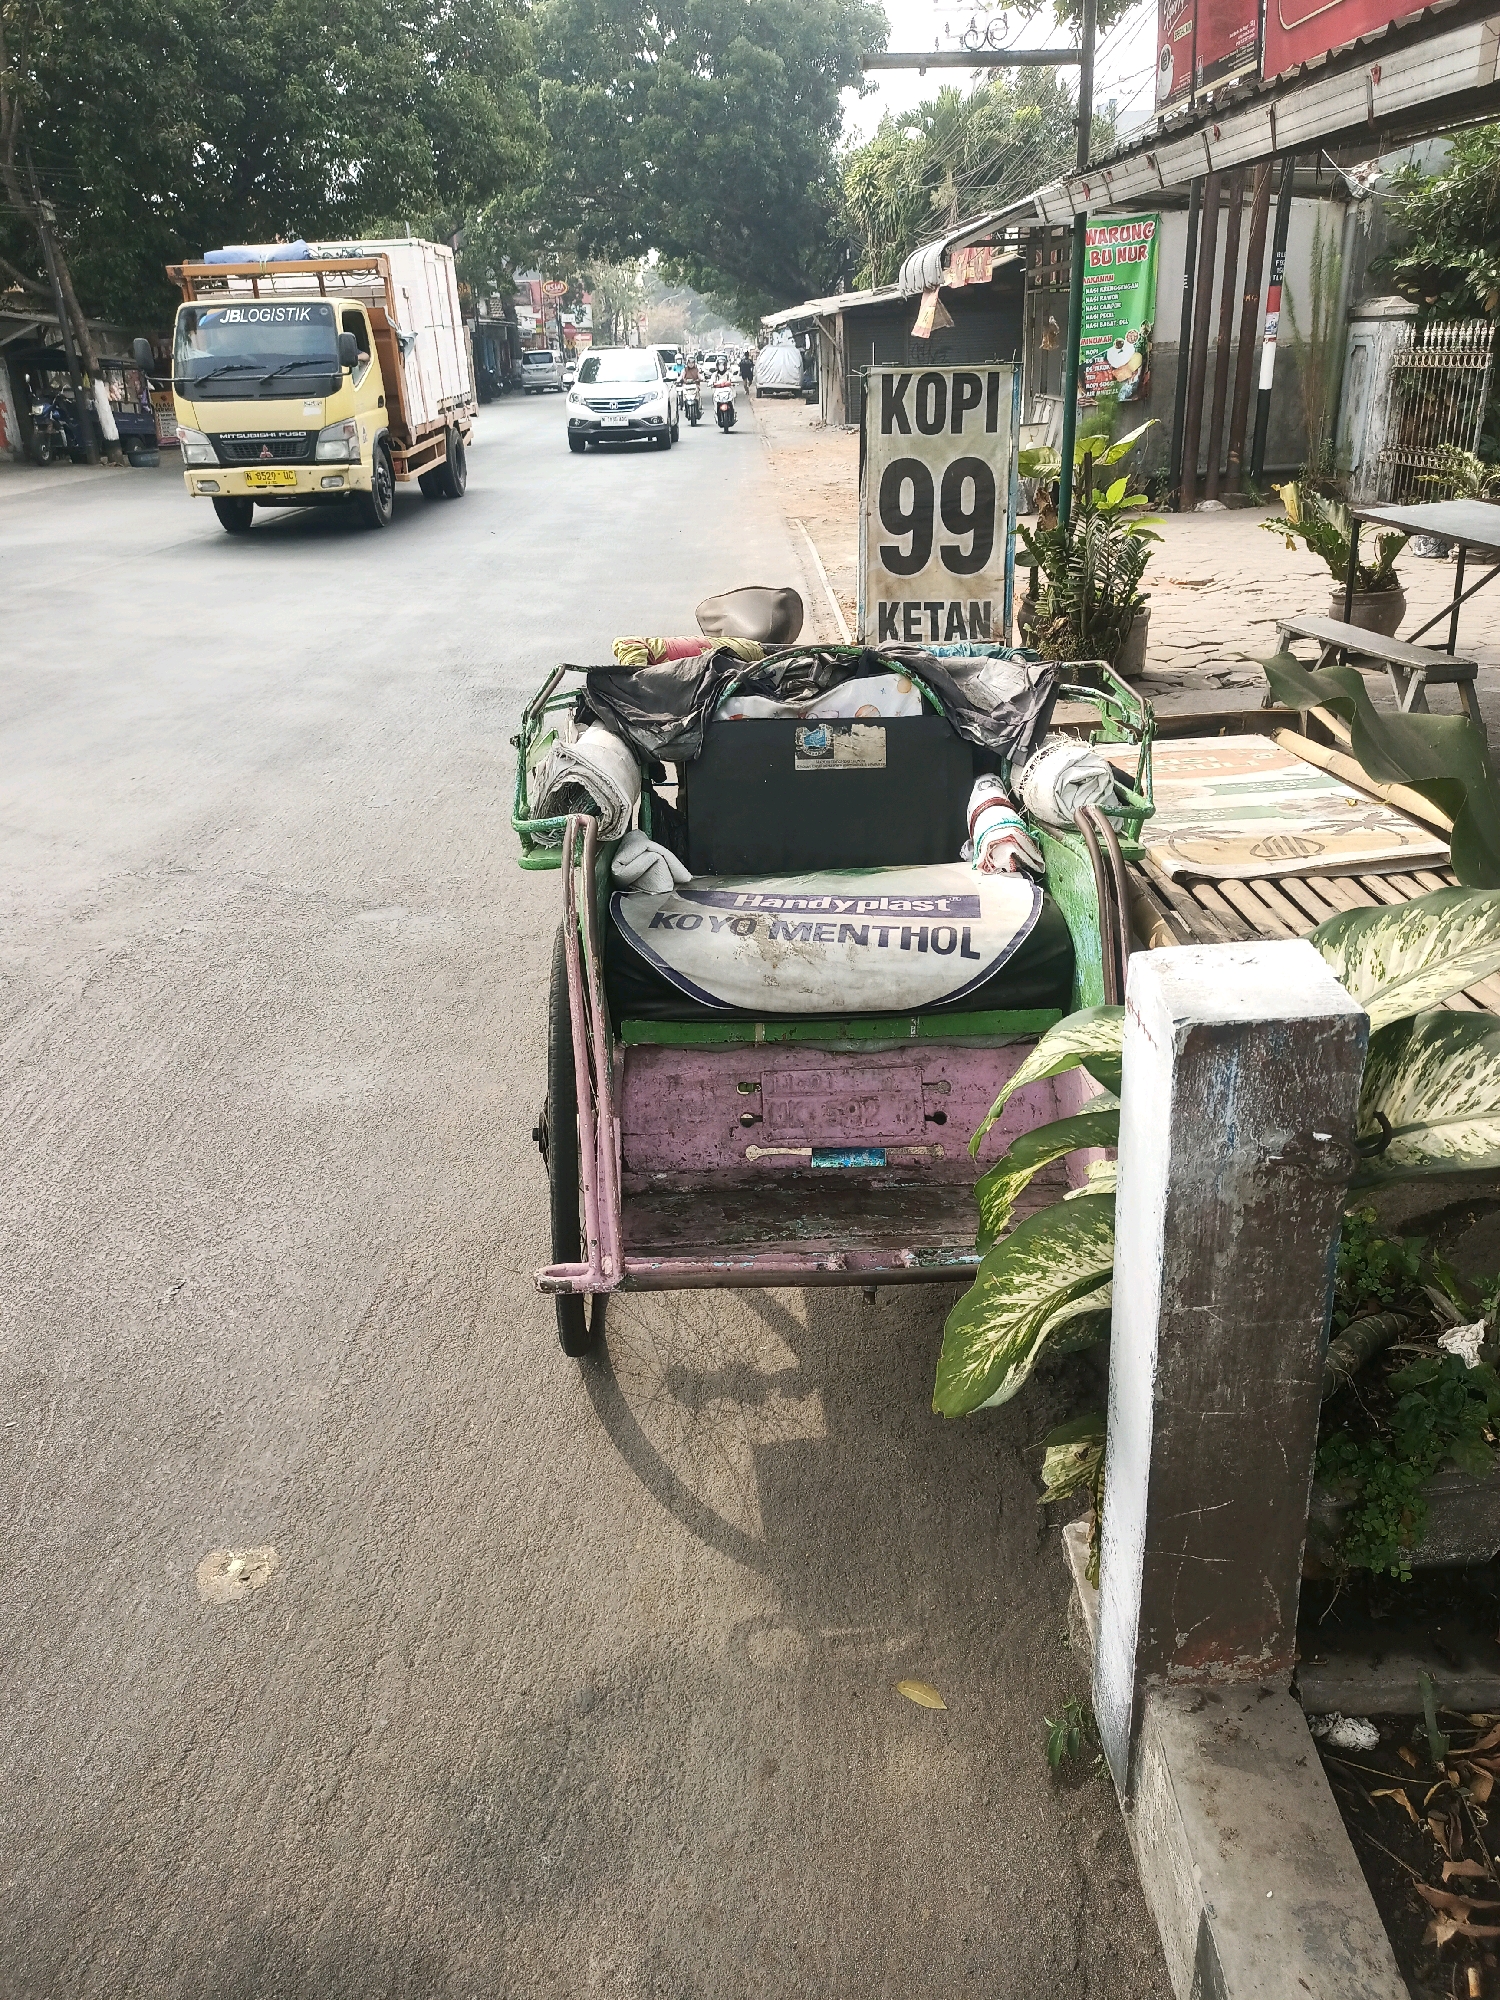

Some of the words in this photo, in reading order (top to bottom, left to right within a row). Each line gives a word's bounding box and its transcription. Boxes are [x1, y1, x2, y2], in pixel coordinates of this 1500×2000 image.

[1085, 221, 1155, 247] WARUNG
[1090, 249, 1112, 267] BU
[1116, 244, 1148, 264] NUR
[1085, 287, 1099, 295] NASI
[1085, 295, 1099, 304] NASI
[1099, 293, 1119, 302] RAWON
[1085, 304, 1099, 312] NASI
[1085, 313, 1099, 321] NASI
[1085, 322, 1099, 330] NASI
[881, 371, 1000, 435] KOPI
[219, 430, 277, 439] MITSUBISHI
[278, 430, 307, 438] FUSO
[879, 456, 996, 576] 99
[878, 600, 992, 643] KETAN
[733, 894, 952, 914] Handyplast
[648, 911, 757, 937] KOYO
[768, 920, 981, 960] MENTHOL
